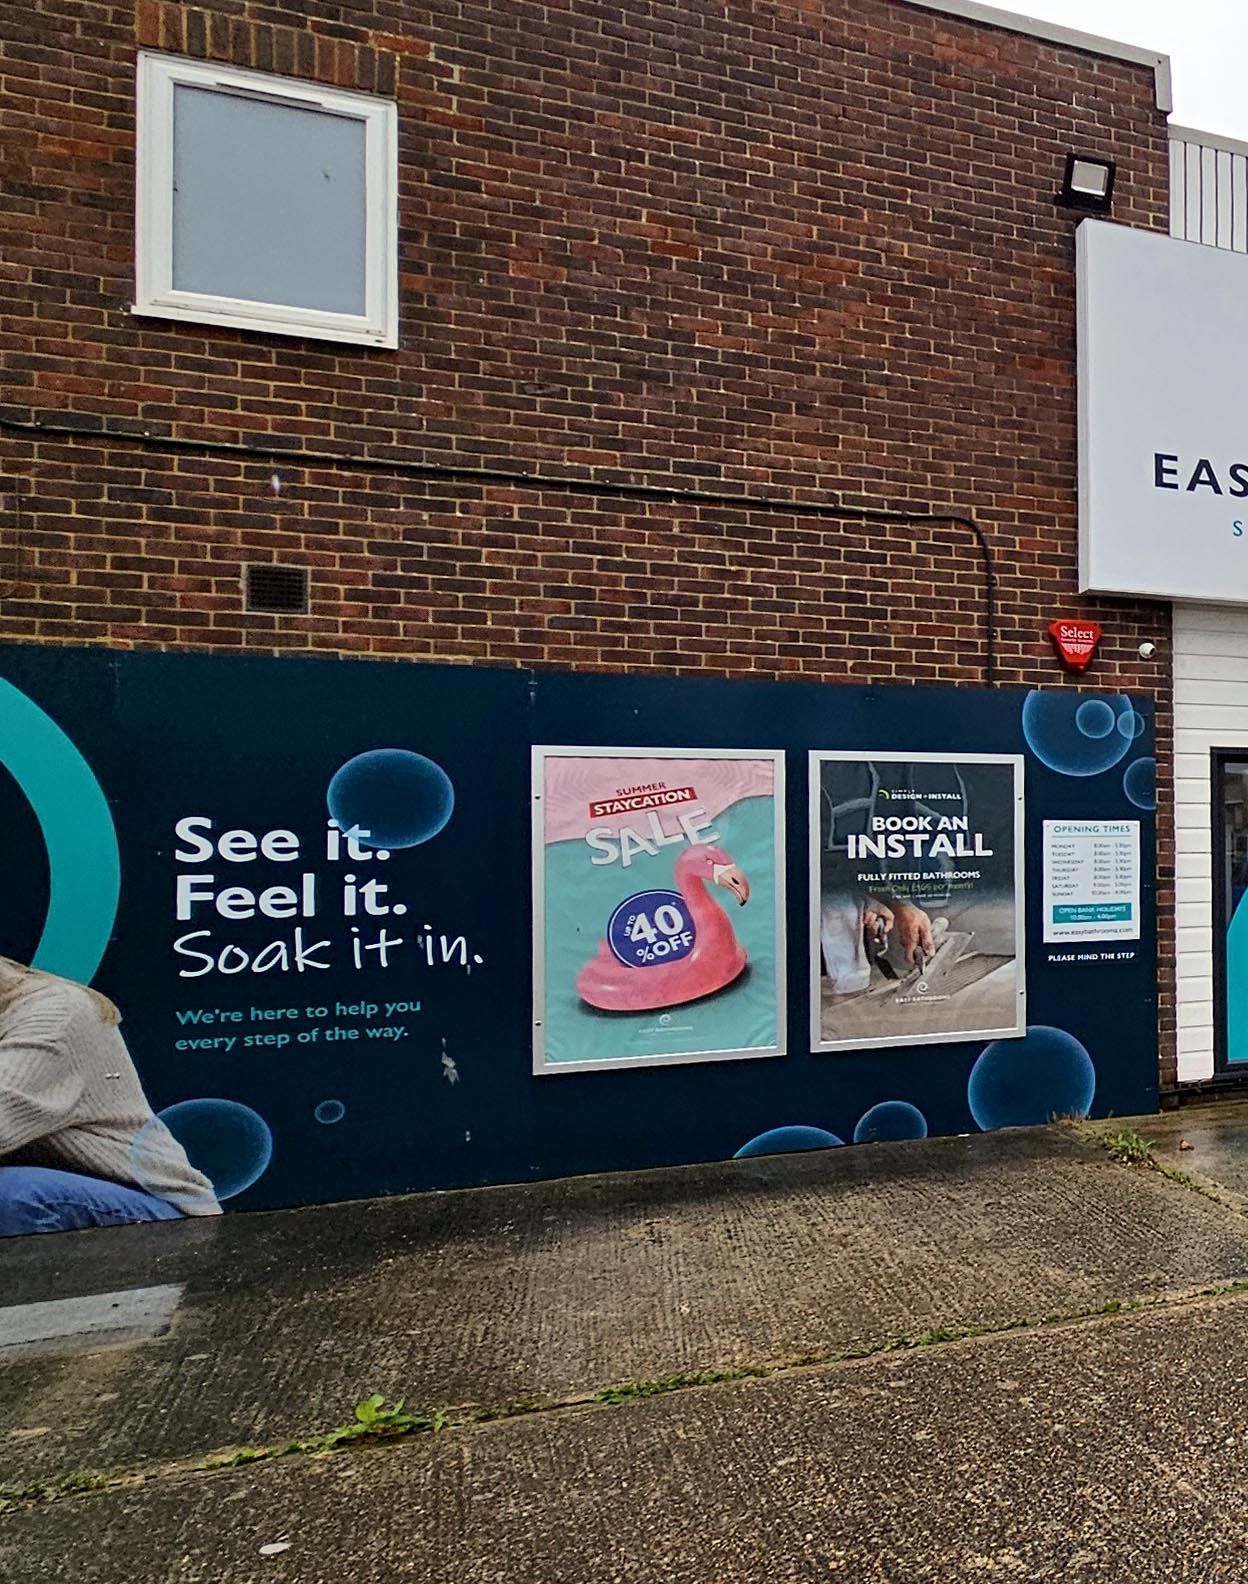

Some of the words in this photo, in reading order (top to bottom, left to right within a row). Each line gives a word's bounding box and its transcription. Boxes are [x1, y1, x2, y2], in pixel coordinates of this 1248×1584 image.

[1060, 625, 1094, 639] Select
[616, 782, 667, 796] SUMMER
[594, 789, 691, 815] STAYCATION
[872, 816, 933, 831] BOOK
[937, 816, 968, 831] AN
[1054, 825, 1099, 833] OPENING
[1103, 825, 1131, 833] TIMES
[175, 816, 300, 863] See
[327, 818, 390, 861] it.
[585, 806, 721, 868] SALE
[847, 833, 994, 859] INSTALL
[858, 873, 887, 881] FULLY
[889, 872, 920, 881] FITTED
[922, 871, 981, 880] BATHROOMS
[176, 873, 315, 920] Feel
[344, 874, 407, 916] it.
[627, 915, 636, 926] TO
[173, 926, 331, 977] Soak
[350, 927, 403, 969] it
[423, 924, 484, 966] in.
[1048, 954, 1076, 962] PLEASE
[1077, 953, 1099, 961] MIND
[1100, 952, 1115, 960] THE
[1116, 952, 1135, 960] STEP
[176, 1008, 243, 1025] We're
[251, 1006, 298, 1021] here
[306, 1005, 328, 1018] to
[336, 1001, 378, 1019] help
[385, 1000, 421, 1019] you
[175, 1035, 240, 1051] every
[244, 1030, 290, 1049] step
[297, 1028, 319, 1043] of
[324, 1025, 360, 1041] the
[366, 1025, 409, 1042] way.
